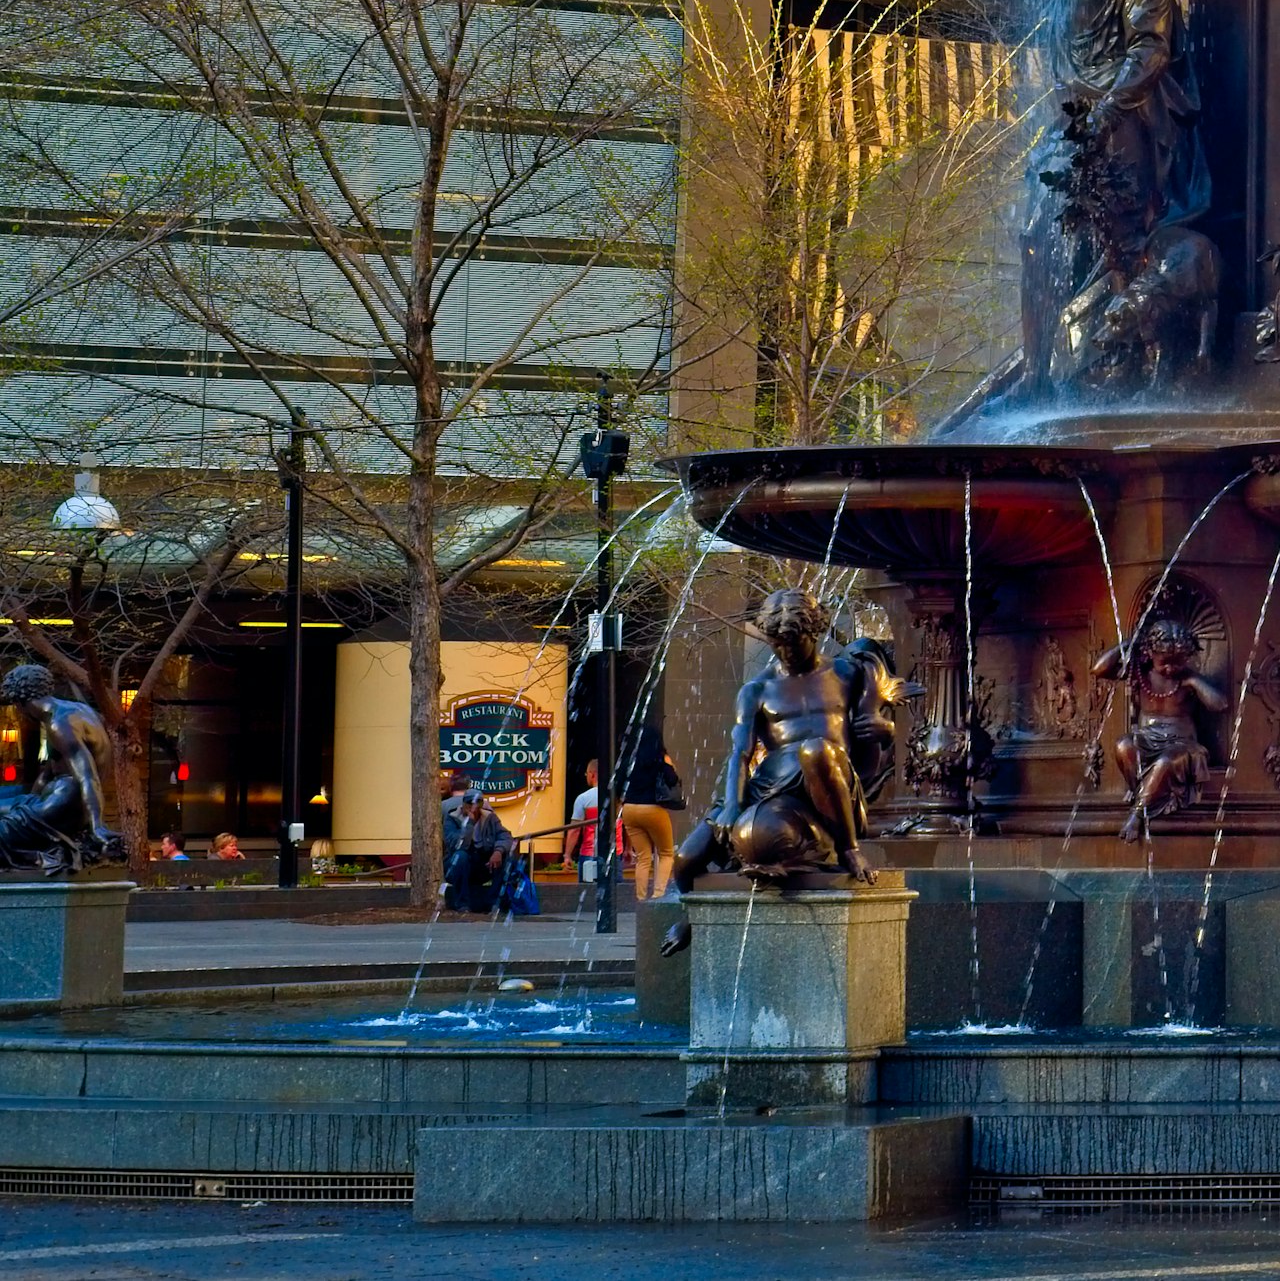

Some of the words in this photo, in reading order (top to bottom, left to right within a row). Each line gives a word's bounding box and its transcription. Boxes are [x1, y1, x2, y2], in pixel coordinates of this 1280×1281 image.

[461, 705, 526, 720] RESTAURANT
[451, 733, 530, 747] ROCK
[439, 749, 545, 764] BOTTOM
[468, 779, 517, 791] BREWERY
